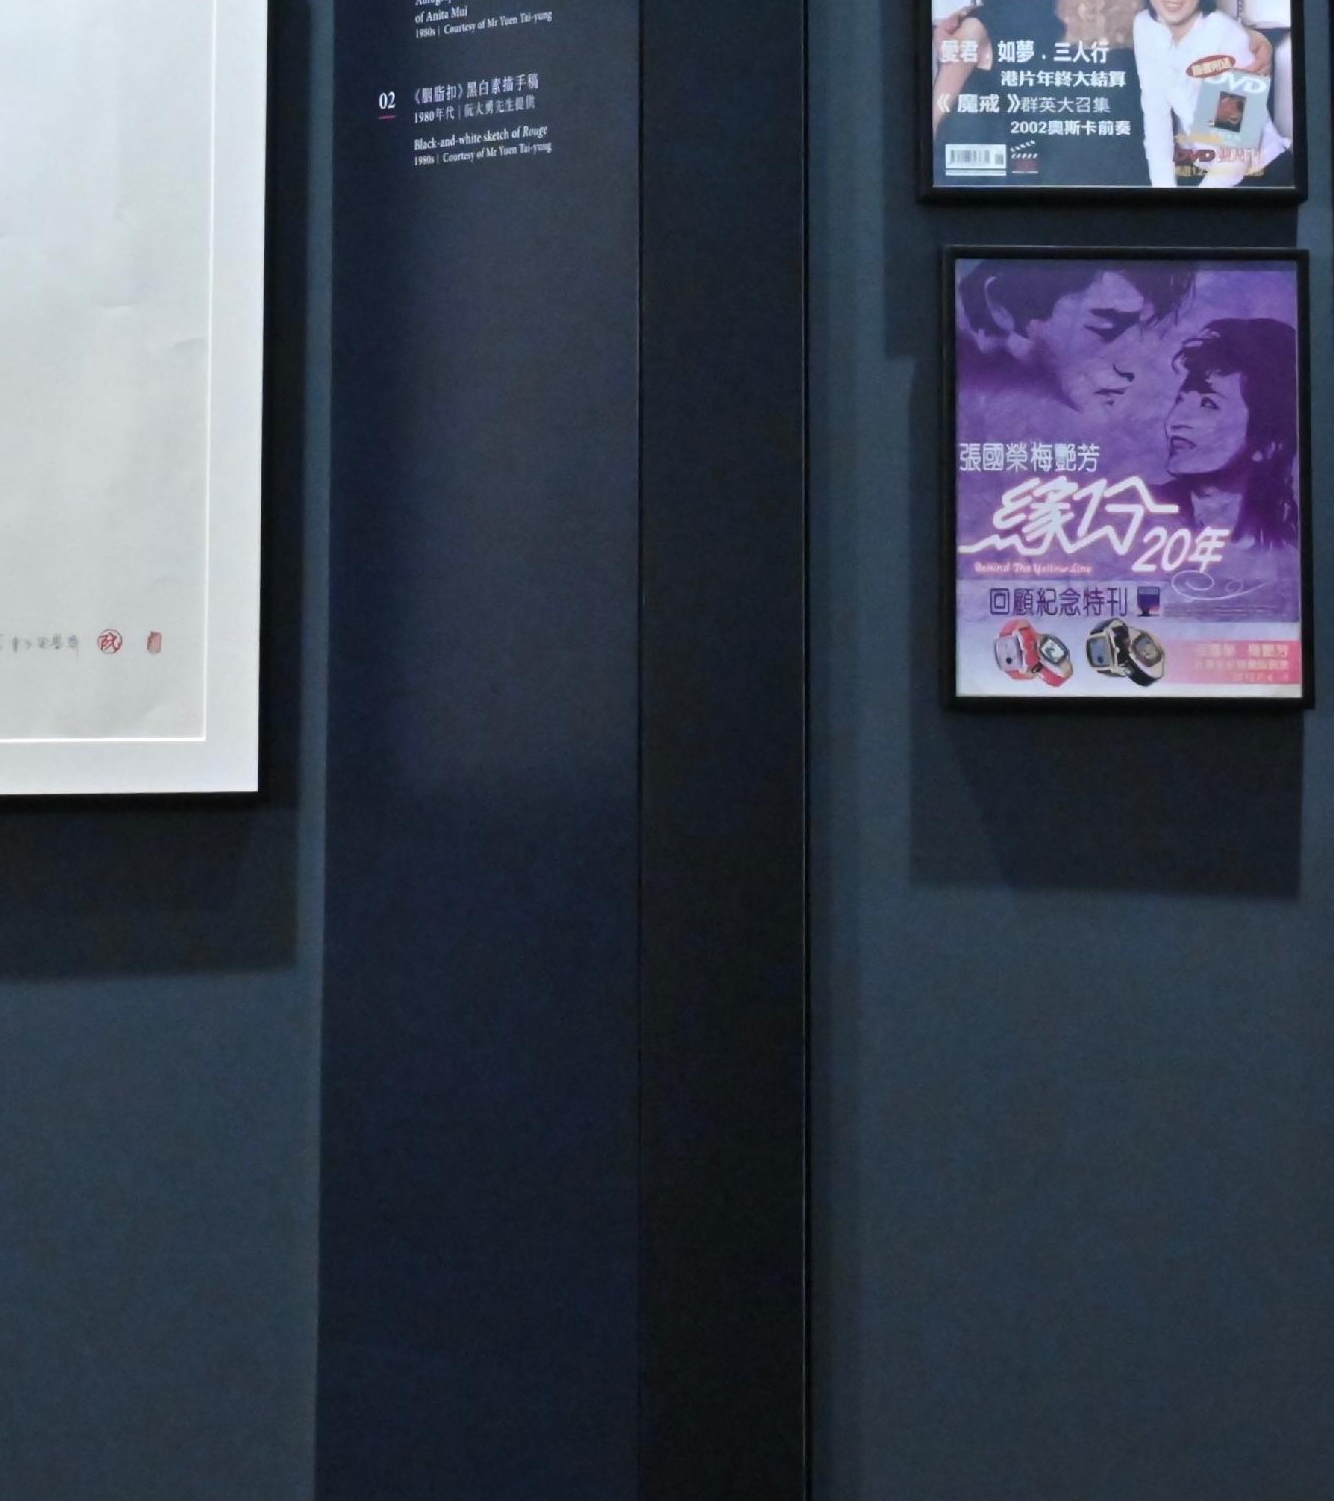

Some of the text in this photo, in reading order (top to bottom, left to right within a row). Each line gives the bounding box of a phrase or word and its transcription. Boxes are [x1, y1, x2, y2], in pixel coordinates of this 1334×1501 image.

[415, 6, 468, 23] of Anita Mui
[416, 27, 435, 38] 1980s
[444, 20, 476, 35] Courtesy
[477, 19, 485, 29] of
[487, 16, 498, 27] Mr
[378, 92, 395, 109] 02
[414, 125, 547, 150] Black-and-white sketch of Rouge
[959, 443, 1100, 473] 張國榮梅艷芳
[990, 586, 1127, 617] 回顧紀念特刊
